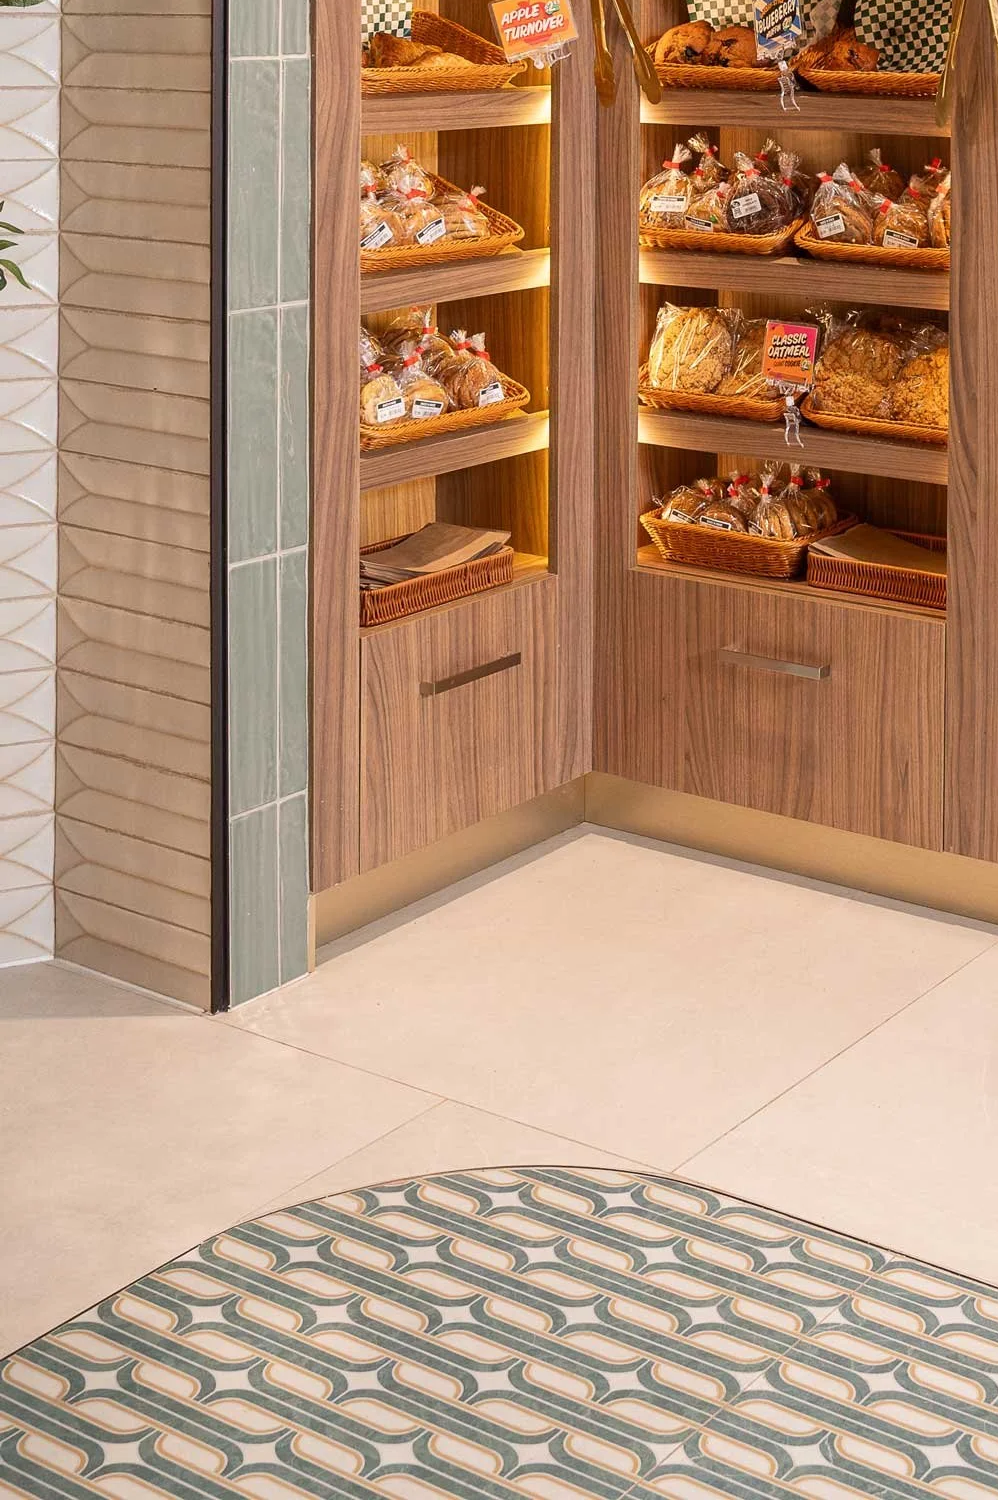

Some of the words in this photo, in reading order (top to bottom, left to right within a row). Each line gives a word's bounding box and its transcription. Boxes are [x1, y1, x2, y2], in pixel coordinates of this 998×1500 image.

[501, 4, 540, 26] APPLE
[504, 14, 564, 42] TURNOVER
[772, 333, 808, 346] CLASSIC
[767, 346, 810, 359] OATMEAL
